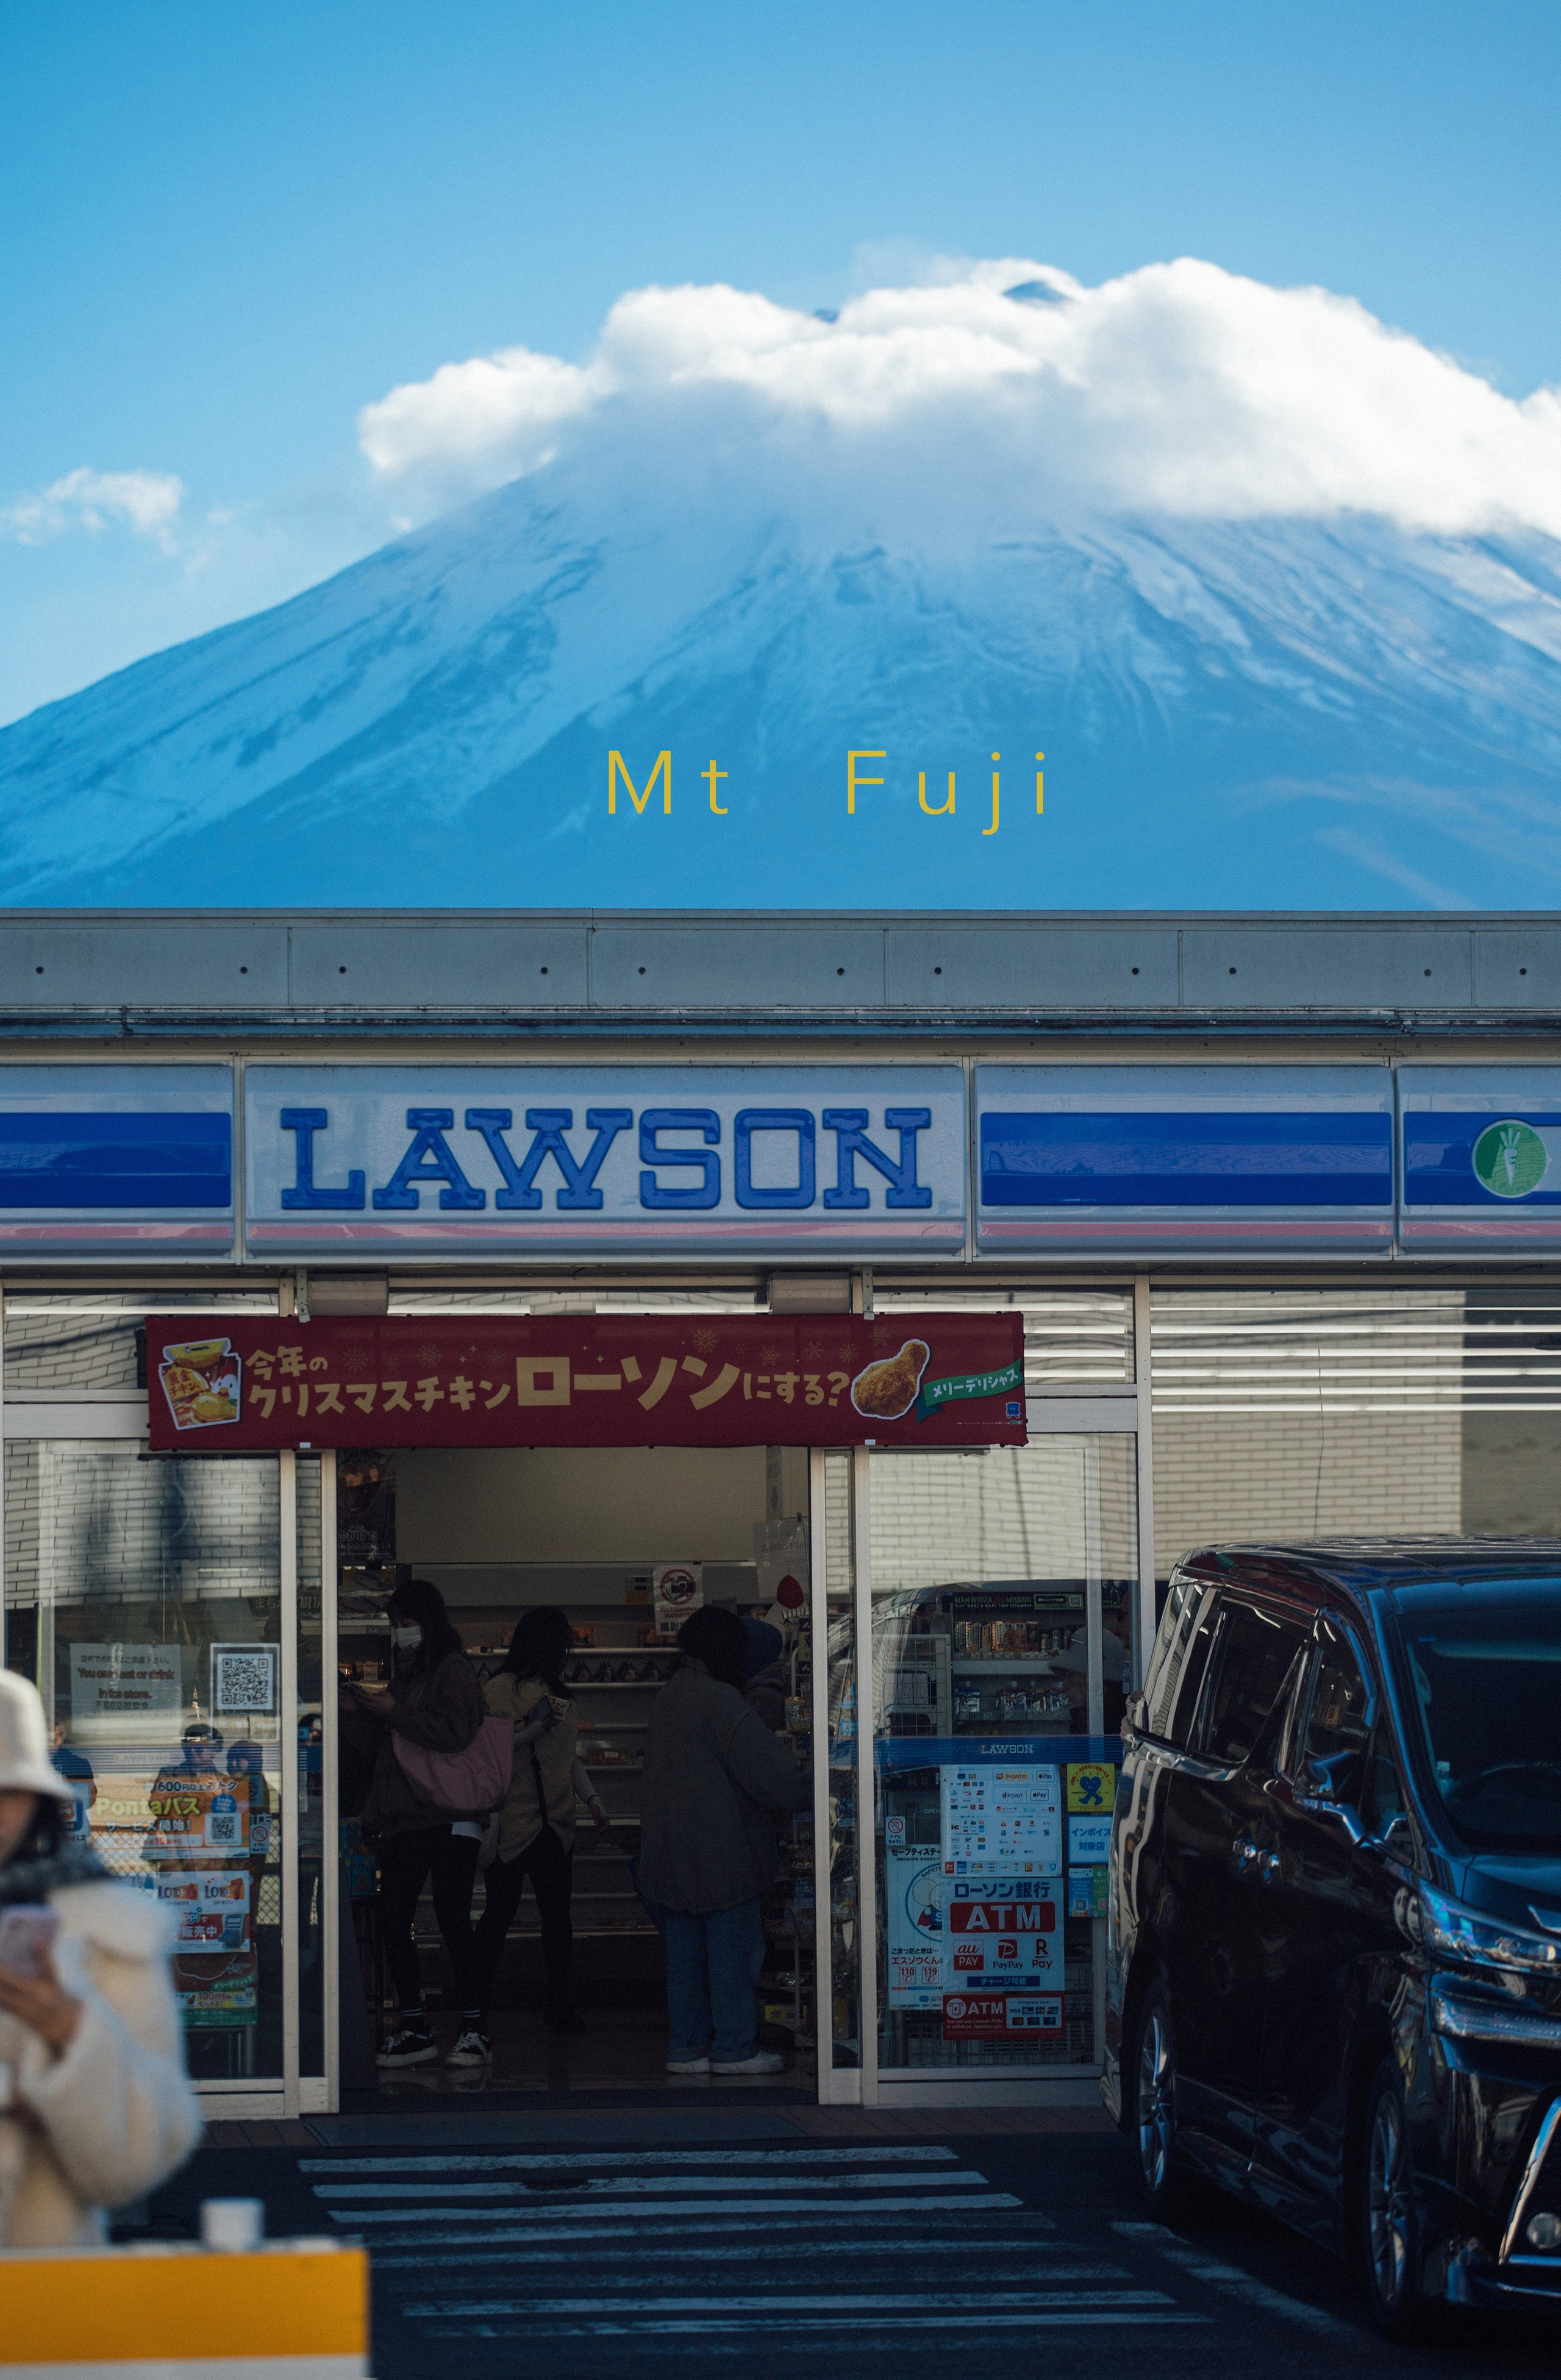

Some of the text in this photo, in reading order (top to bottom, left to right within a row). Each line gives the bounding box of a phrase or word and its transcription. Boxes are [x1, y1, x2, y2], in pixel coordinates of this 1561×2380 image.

[280, 1108, 932, 1210] LAWSON
[245, 1345, 328, 1381] 今年の
[933, 1368, 1019, 1398] メリーデリシャス
[981, 1744, 1034, 1754] LAWSON
[95, 1797, 201, 1816] Pontaパス
[1071, 1828, 1111, 1837] インボイス
[1079, 1842, 1105, 1851] 対象店
[954, 1881, 1051, 1898] ローソン銀行
[965, 1904, 1041, 1930] ATM
[957, 1944, 980, 1954] au
[959, 1956, 979, 1966] PAY
[993, 1961, 1024, 1969] PayPay
[1032, 1959, 1052, 1970] Pay
[968, 2002, 1003, 2015] ATM
